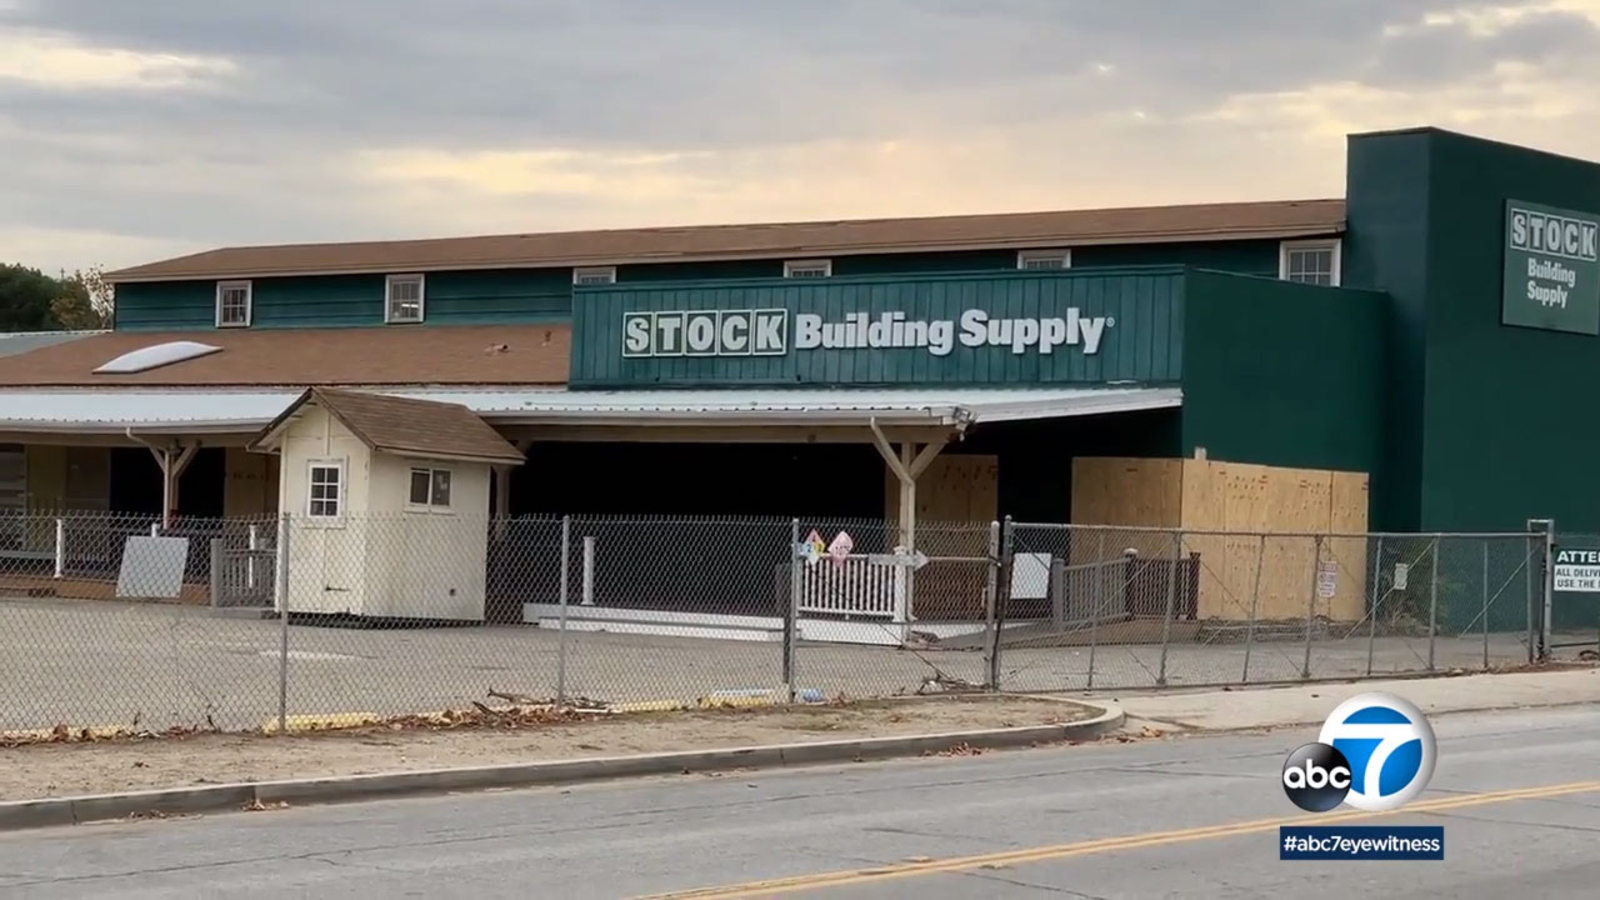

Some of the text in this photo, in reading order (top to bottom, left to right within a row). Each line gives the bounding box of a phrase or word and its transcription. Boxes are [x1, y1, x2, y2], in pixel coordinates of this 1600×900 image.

[1512, 212, 1597, 258] STOCK
[1527, 257, 1576, 288] Building
[1527, 280, 1568, 309] Supply
[625, 312, 785, 353] STOCK
[795, 312, 954, 355] Building
[1556, 551, 1600, 563] ATTE
[1556, 568, 1600, 578] ALL DELIV
[1557, 579, 1575, 588] USE
[1578, 579, 1595, 588] THE
